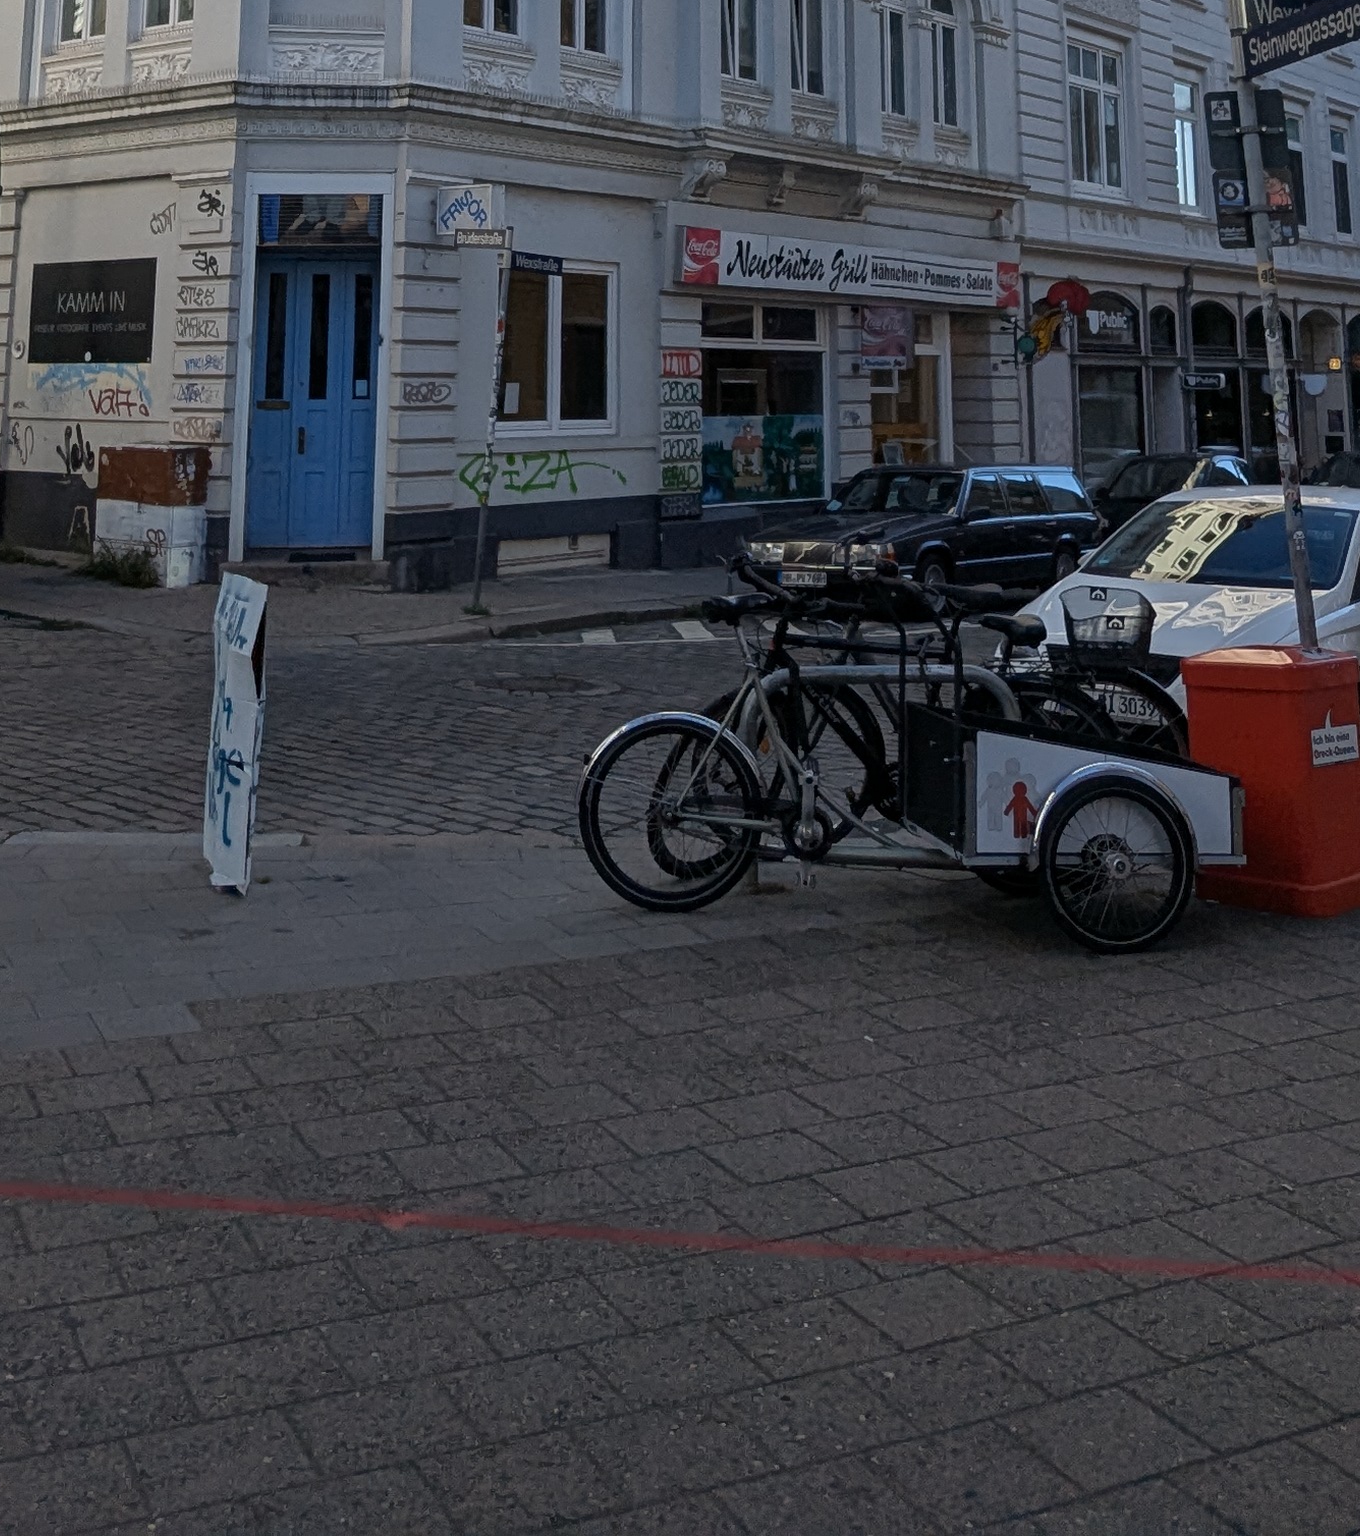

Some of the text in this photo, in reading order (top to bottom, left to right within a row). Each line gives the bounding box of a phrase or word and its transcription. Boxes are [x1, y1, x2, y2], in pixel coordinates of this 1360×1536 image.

[515, 253, 559, 272] Wexstraße
[727, 240, 993, 291] Neustädter Grill Hähnchen Pommes Salate
[57, 291, 125, 313] KAMM IN
[1100, 311, 1127, 328] Public
